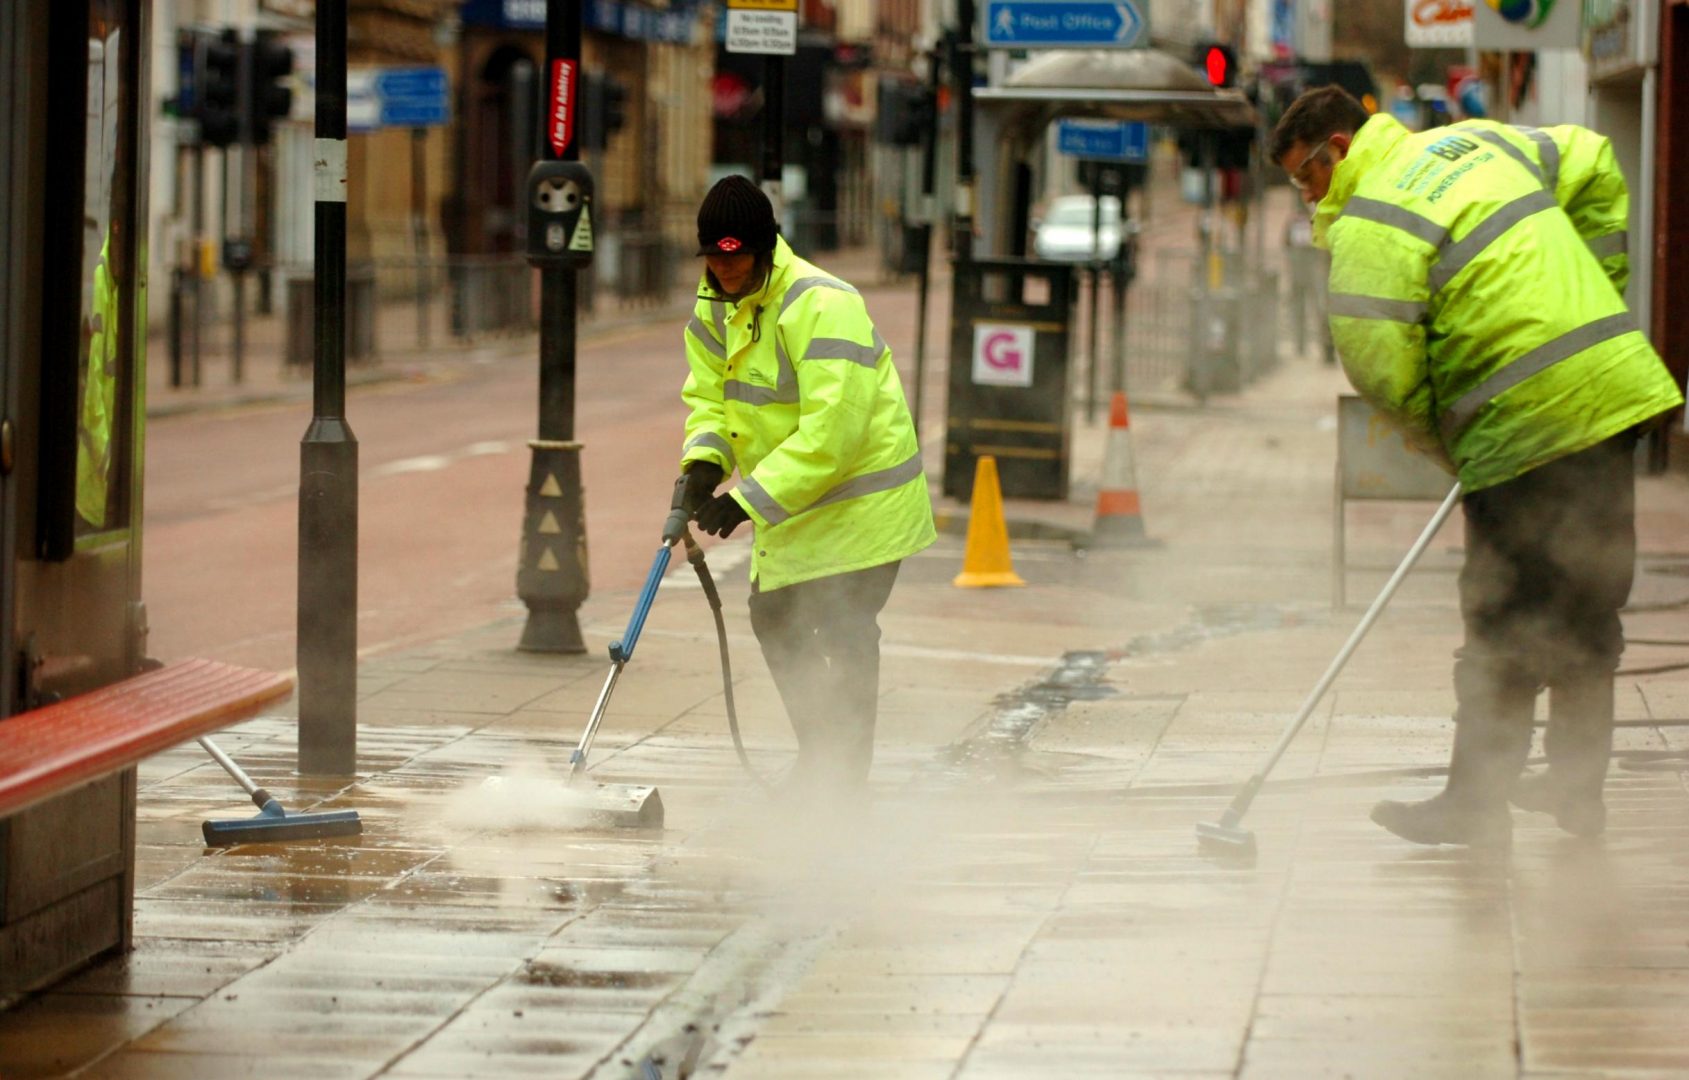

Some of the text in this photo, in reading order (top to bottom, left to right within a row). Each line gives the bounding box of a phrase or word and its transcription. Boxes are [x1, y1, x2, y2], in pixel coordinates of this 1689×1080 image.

[1020, 12, 1113, 30] Post Office
[556, 62, 572, 104] Ashtray
[555, 105, 567, 121] An
[554, 122, 566, 140] Am
[983, 332, 1020, 370] G
